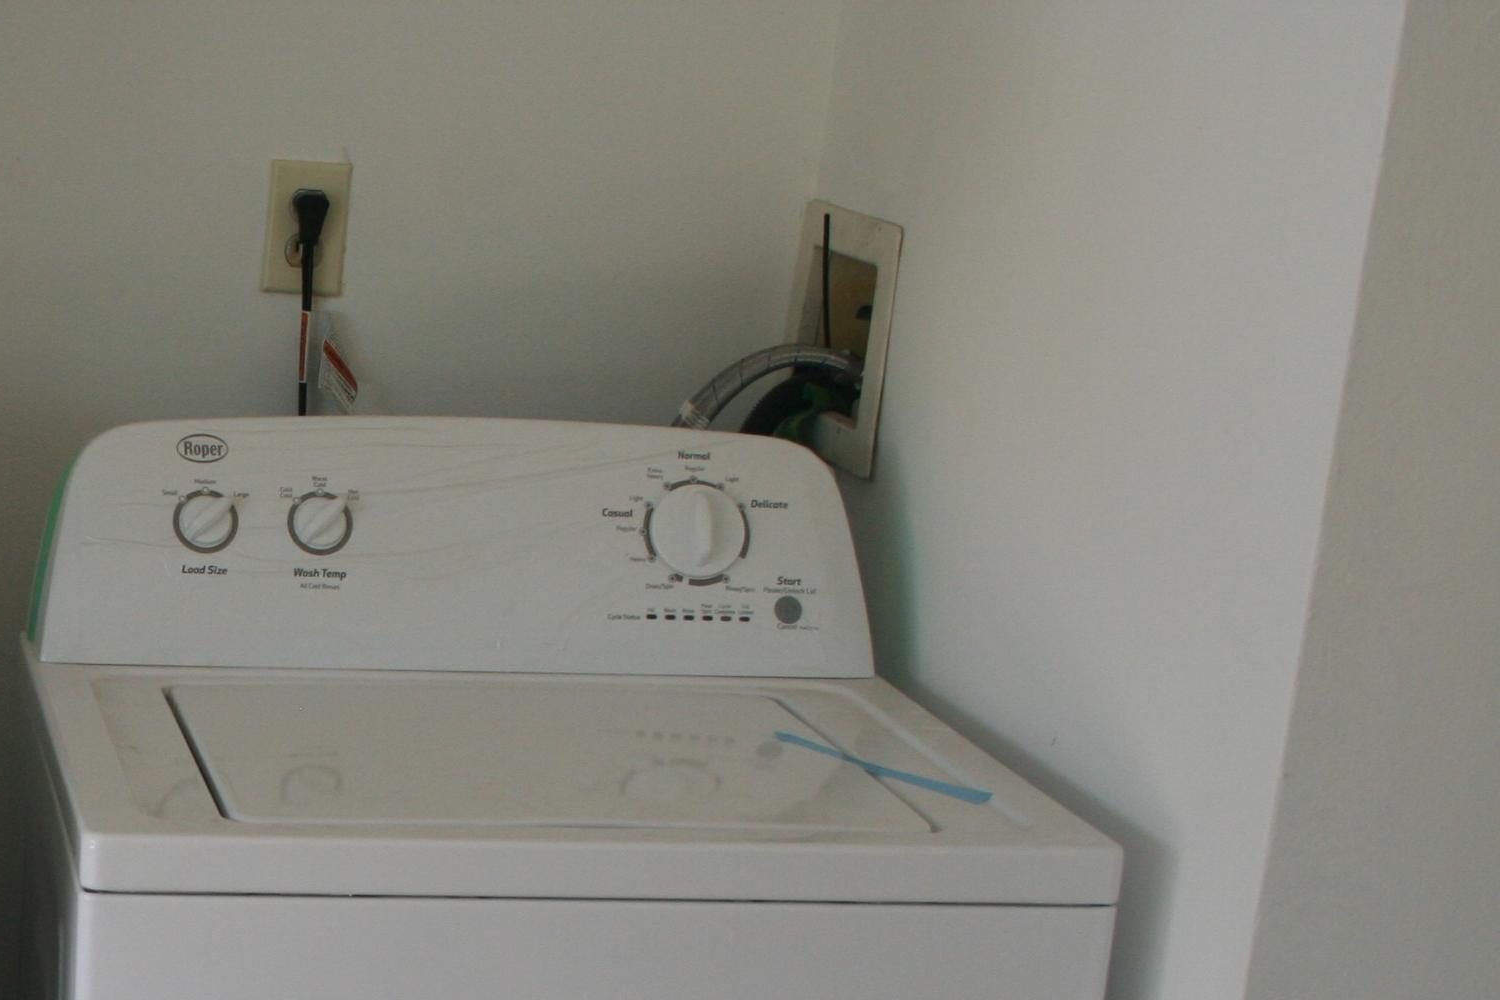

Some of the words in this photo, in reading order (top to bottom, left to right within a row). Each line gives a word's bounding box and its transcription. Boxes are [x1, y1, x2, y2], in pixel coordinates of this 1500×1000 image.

[183, 441, 224, 458] Roper
[677, 451, 710, 460] Normal
[750, 499, 788, 509] Delicate
[602, 508, 633, 518] Casual
[182, 564, 206, 574] Load
[207, 565, 228, 575] Size
[293, 567, 320, 578] Wash
[322, 569, 347, 580] Temp
[777, 577, 802, 586] Start
